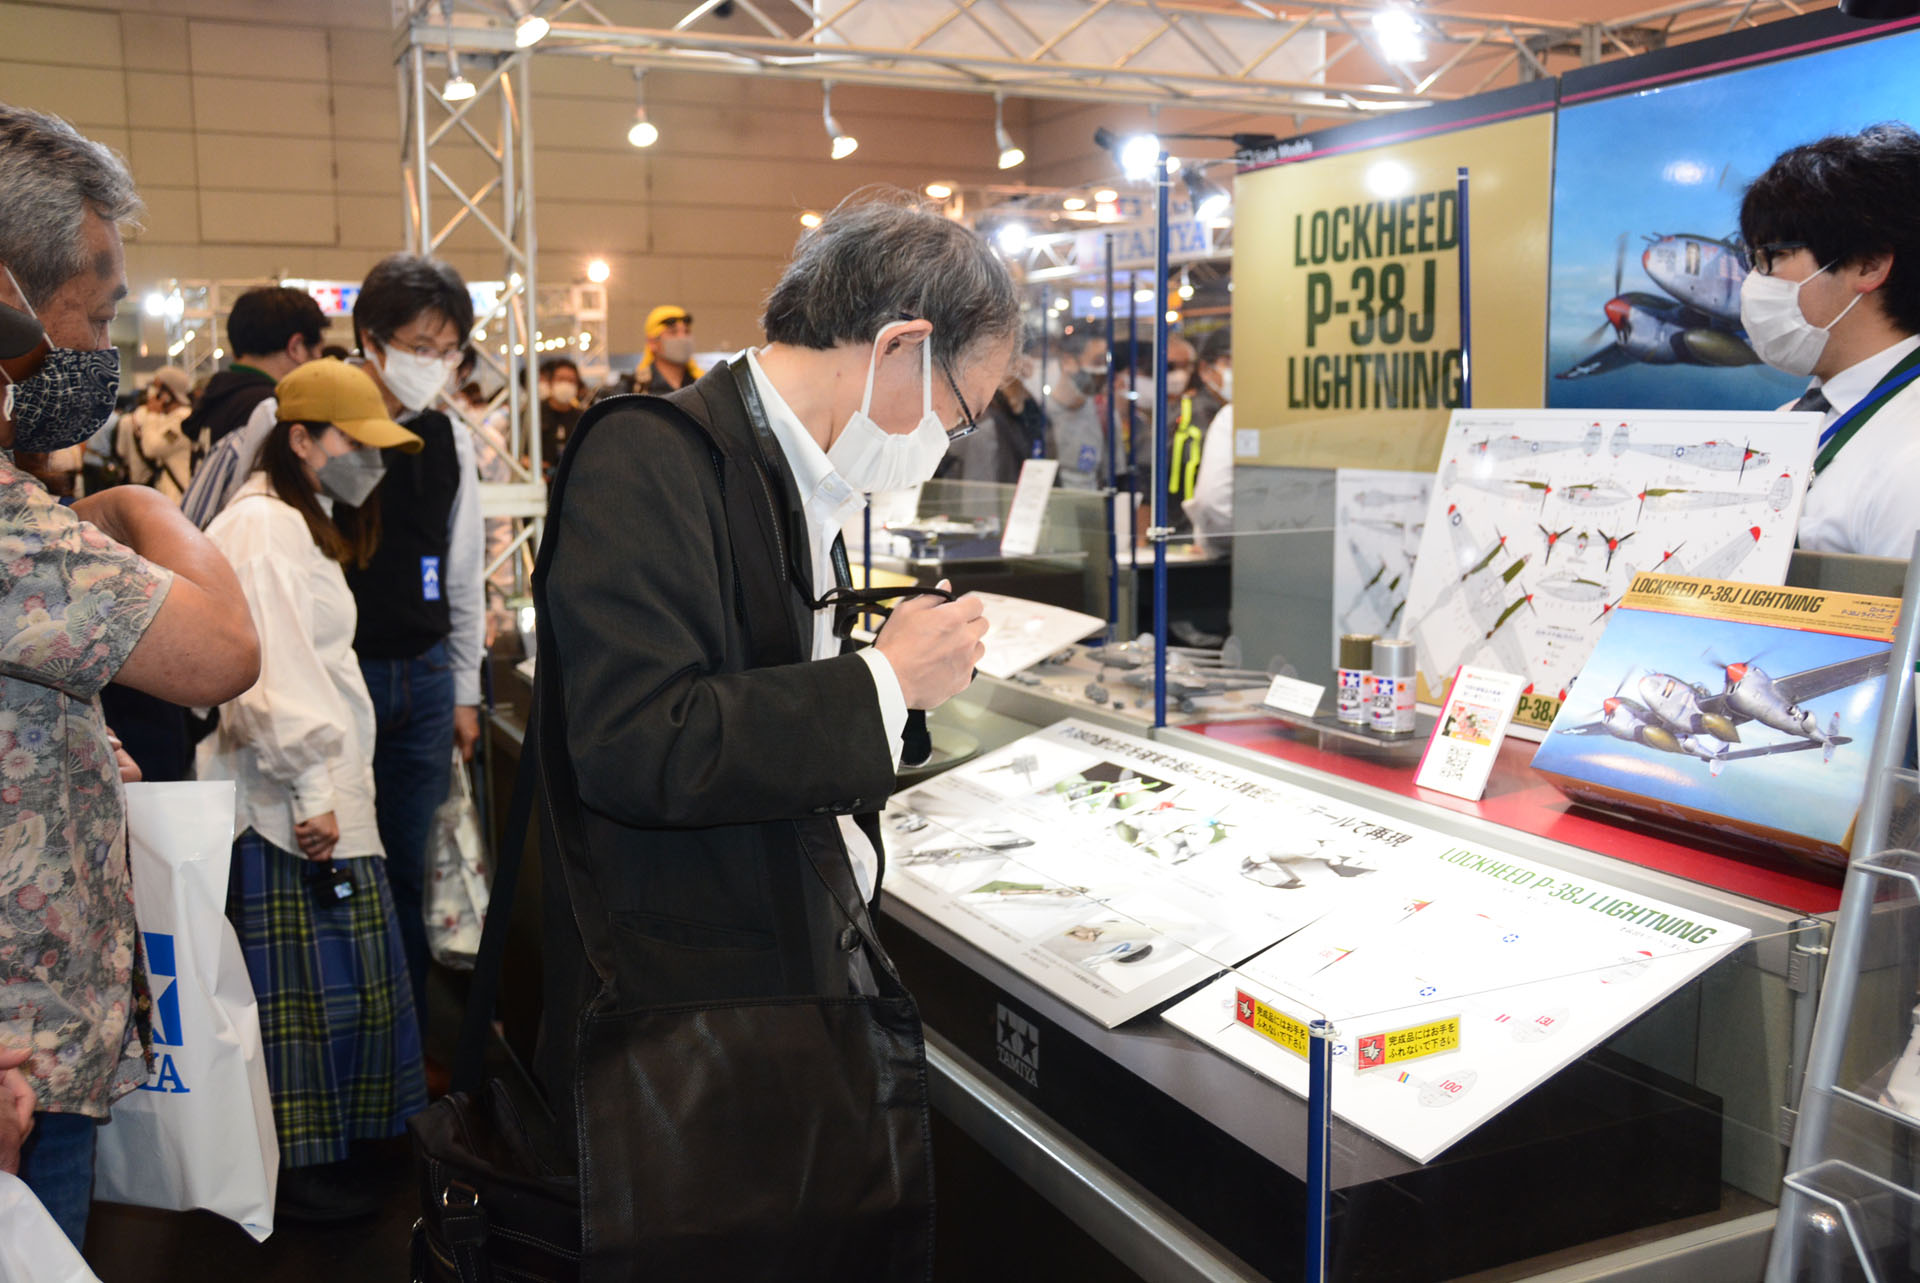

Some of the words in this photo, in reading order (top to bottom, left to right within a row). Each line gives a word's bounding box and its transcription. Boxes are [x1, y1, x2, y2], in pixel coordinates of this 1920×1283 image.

[1295, 190, 1459, 267] LOCKHEED
[1306, 259, 1437, 347] P-38J
[1288, 348, 1462, 410] LIGHTNING
[1631, 577, 1698, 597] LOCKHEED
[1698, 584, 1742, 605] P-38J
[1741, 588, 1825, 613] LIGHTNING
[1439, 847, 1537, 886] LOCKHEED
[1530, 877, 1597, 906] P-38J
[1589, 896, 1718, 945] LIGHTNING
[1388, 1023, 1456, 1046] 完成品にはお手を
[1388, 1036, 1456, 1059] ふれないで下さい
[996, 1045, 1039, 1088] TAMIYA
[1438, 1079, 1463, 1095] 100
